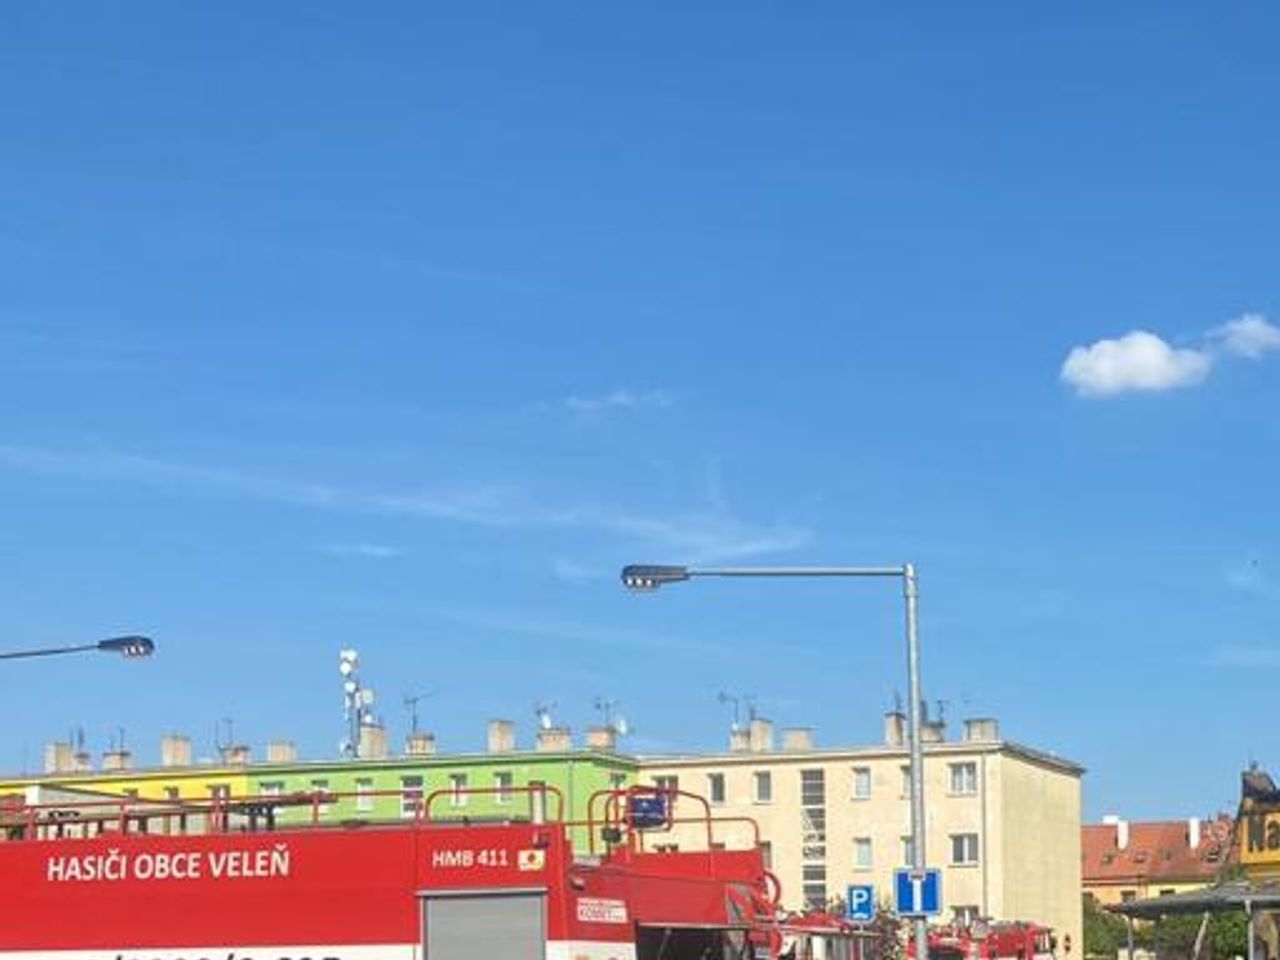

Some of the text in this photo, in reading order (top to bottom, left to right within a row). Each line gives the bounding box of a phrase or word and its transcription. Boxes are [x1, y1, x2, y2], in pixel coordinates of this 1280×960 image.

[47, 844, 290, 881] HASIČI OBCE VELEŇ
[432, 849, 508, 867] HMB 411
[852, 889, 869, 911] P
